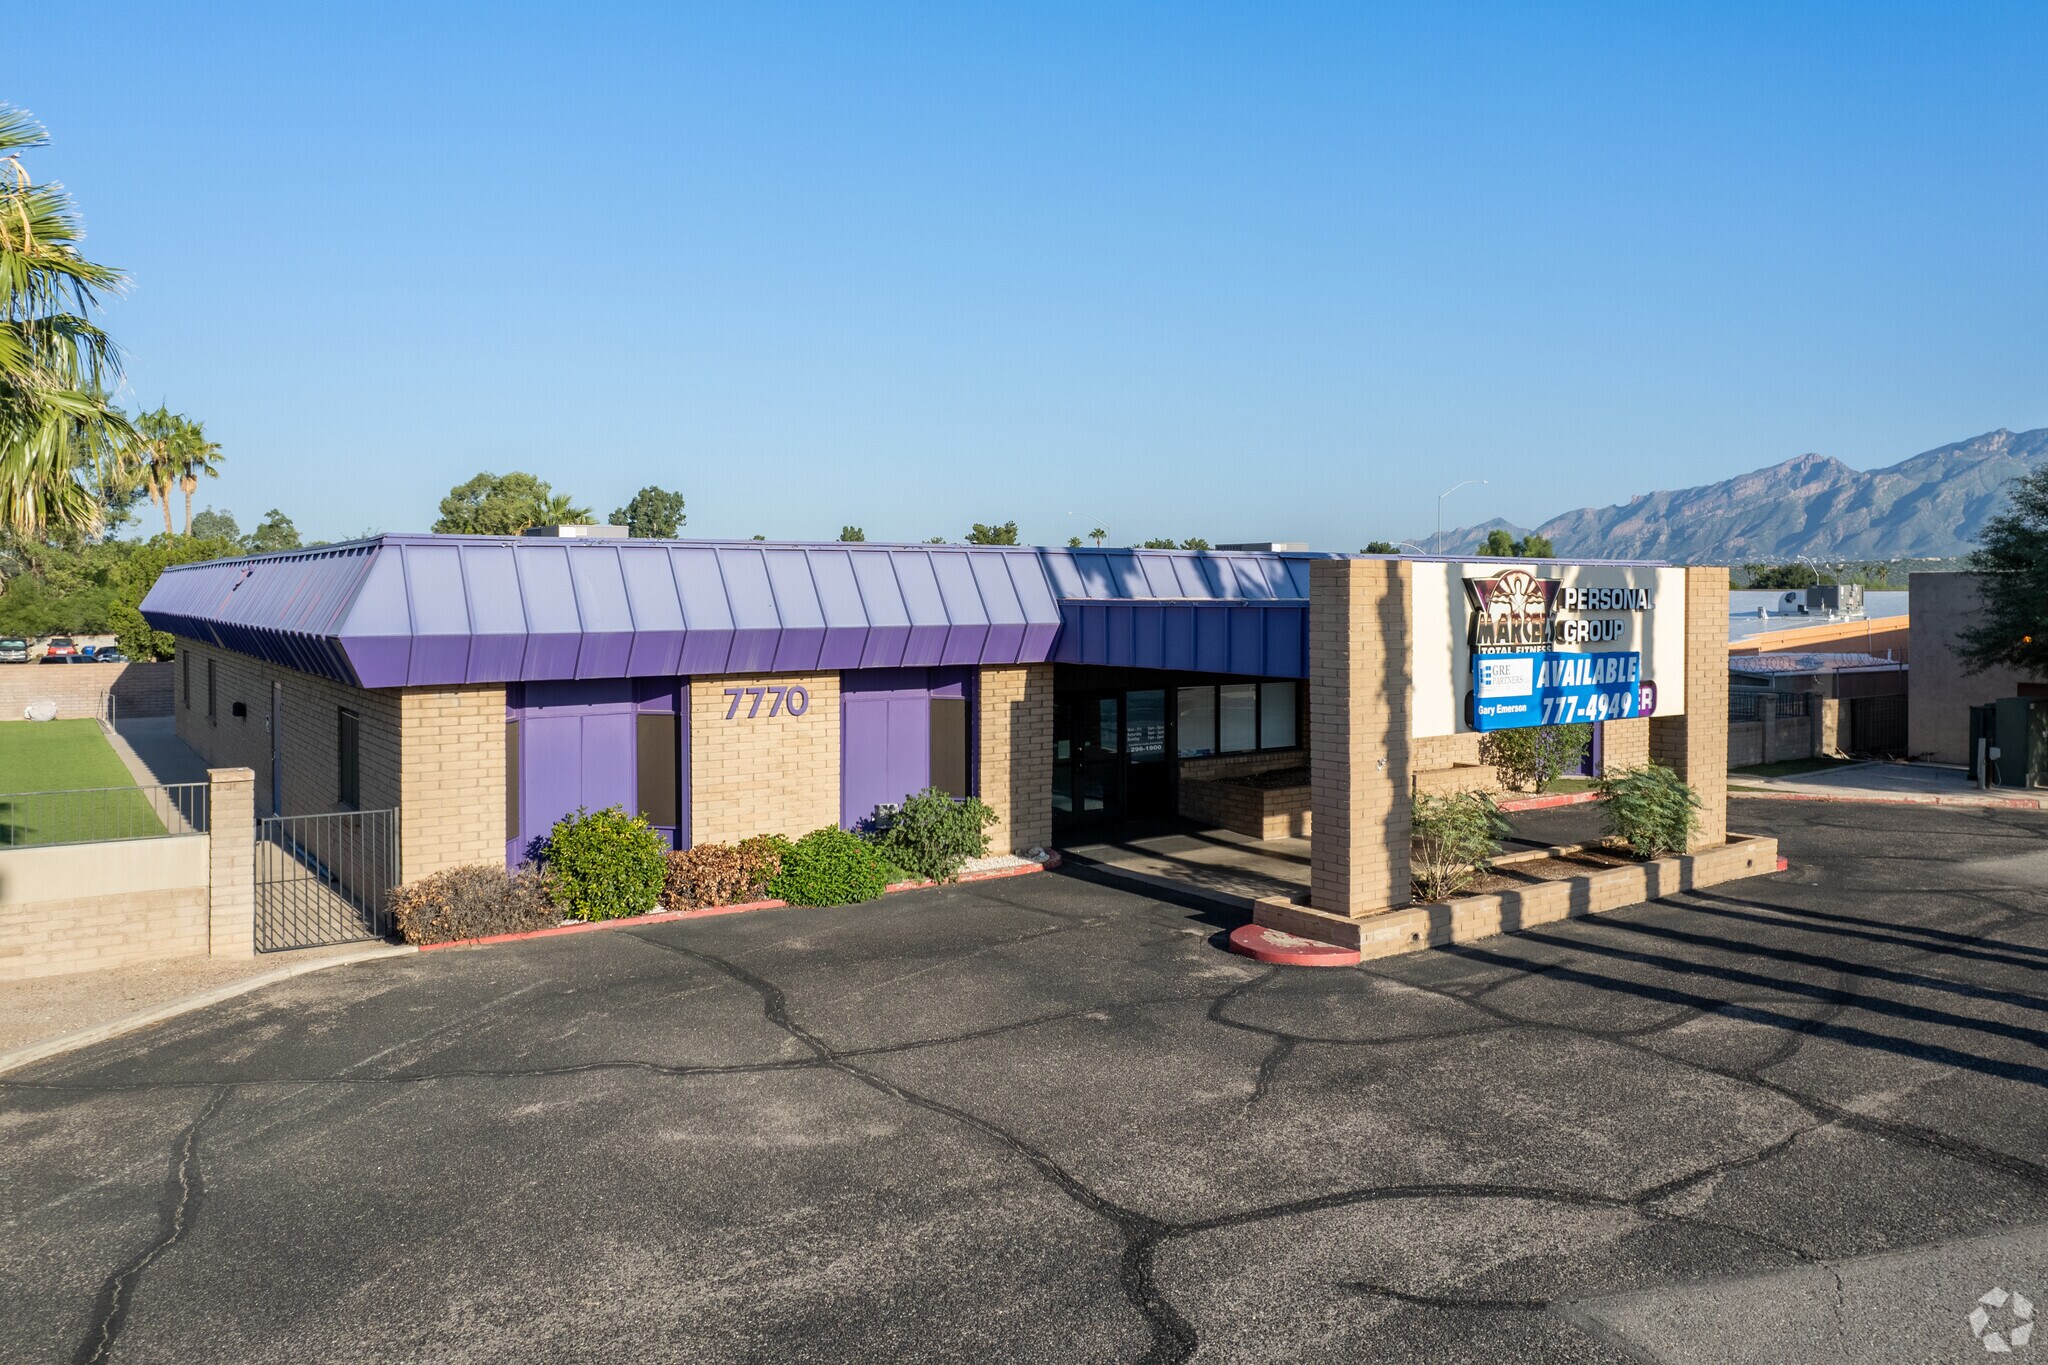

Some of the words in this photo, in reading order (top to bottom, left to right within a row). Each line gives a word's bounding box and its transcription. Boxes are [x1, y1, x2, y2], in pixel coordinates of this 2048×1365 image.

[1565, 587, 1655, 610] PERSONAL
[1564, 620, 1625, 642] GROUP
[1481, 646, 1513, 655] TOTAL
[1516, 645, 1552, 654] FITNESS
[1492, 664, 1511, 676] GRE
[1492, 675, 1524, 685] PARTNERS
[1536, 656, 1637, 689] AVAILABLE
[724, 685, 809, 720] 7770
[1478, 704, 1496, 717] Gary
[1496, 704, 1527, 714] Emerson
[1541, 691, 1632, 725] 777-4949
